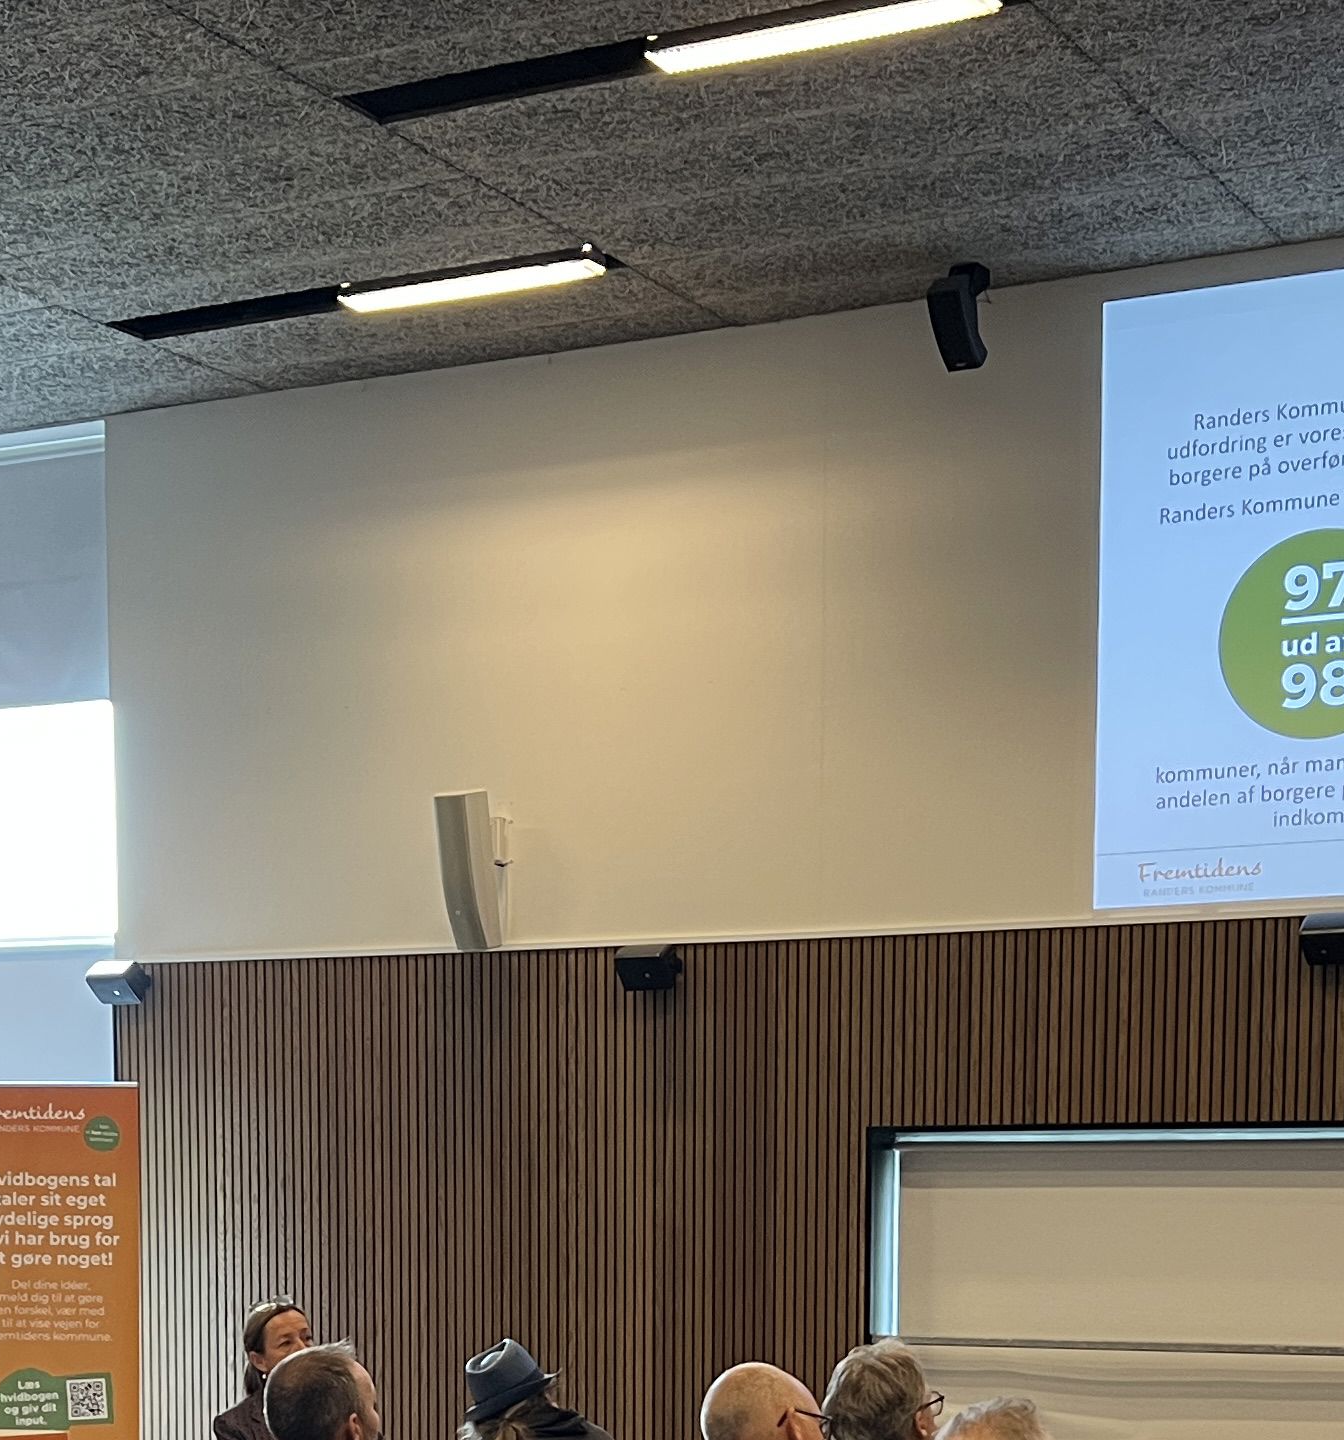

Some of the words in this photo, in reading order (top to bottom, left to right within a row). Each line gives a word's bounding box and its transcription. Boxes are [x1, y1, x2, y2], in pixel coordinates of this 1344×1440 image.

[1194, 408, 1269, 430] Randers
[1168, 435, 1266, 459] udfordring
[1273, 431, 1292, 447] er
[1170, 466, 1241, 486] borgere
[1249, 457, 1271, 480] på
[1160, 503, 1234, 524] Randers
[1242, 491, 1339, 516] Kommune
[1281, 633, 1317, 656] ud
[1156, 763, 1261, 783] kommuner,
[1268, 757, 1298, 776] når
[1156, 790, 1230, 809] andelen
[1237, 783, 1255, 804] af
[1261, 784, 1335, 803] borgere
[1138, 857, 1261, 882] Fremtidens
[94, 1173, 116, 1187] tal
[41, 1192, 61, 1206] sit
[66, 1194, 106, 1209] eget
[64, 1215, 114, 1229] sprog
[15, 1231, 44, 1245] har
[50, 1232, 90, 1249] brug
[95, 1232, 120, 1245] for
[11, 1254, 52, 1268] gøre
[57, 1252, 113, 1268] noget!
[18, 1381, 40, 1389] Læs
[0, 1391, 59, 1403] hvidbogen
[4, 1407, 19, 1415] og
[22, 1404, 39, 1415] giv
[42, 1403, 57, 1411] dit
[16, 1415, 47, 1425] input.
